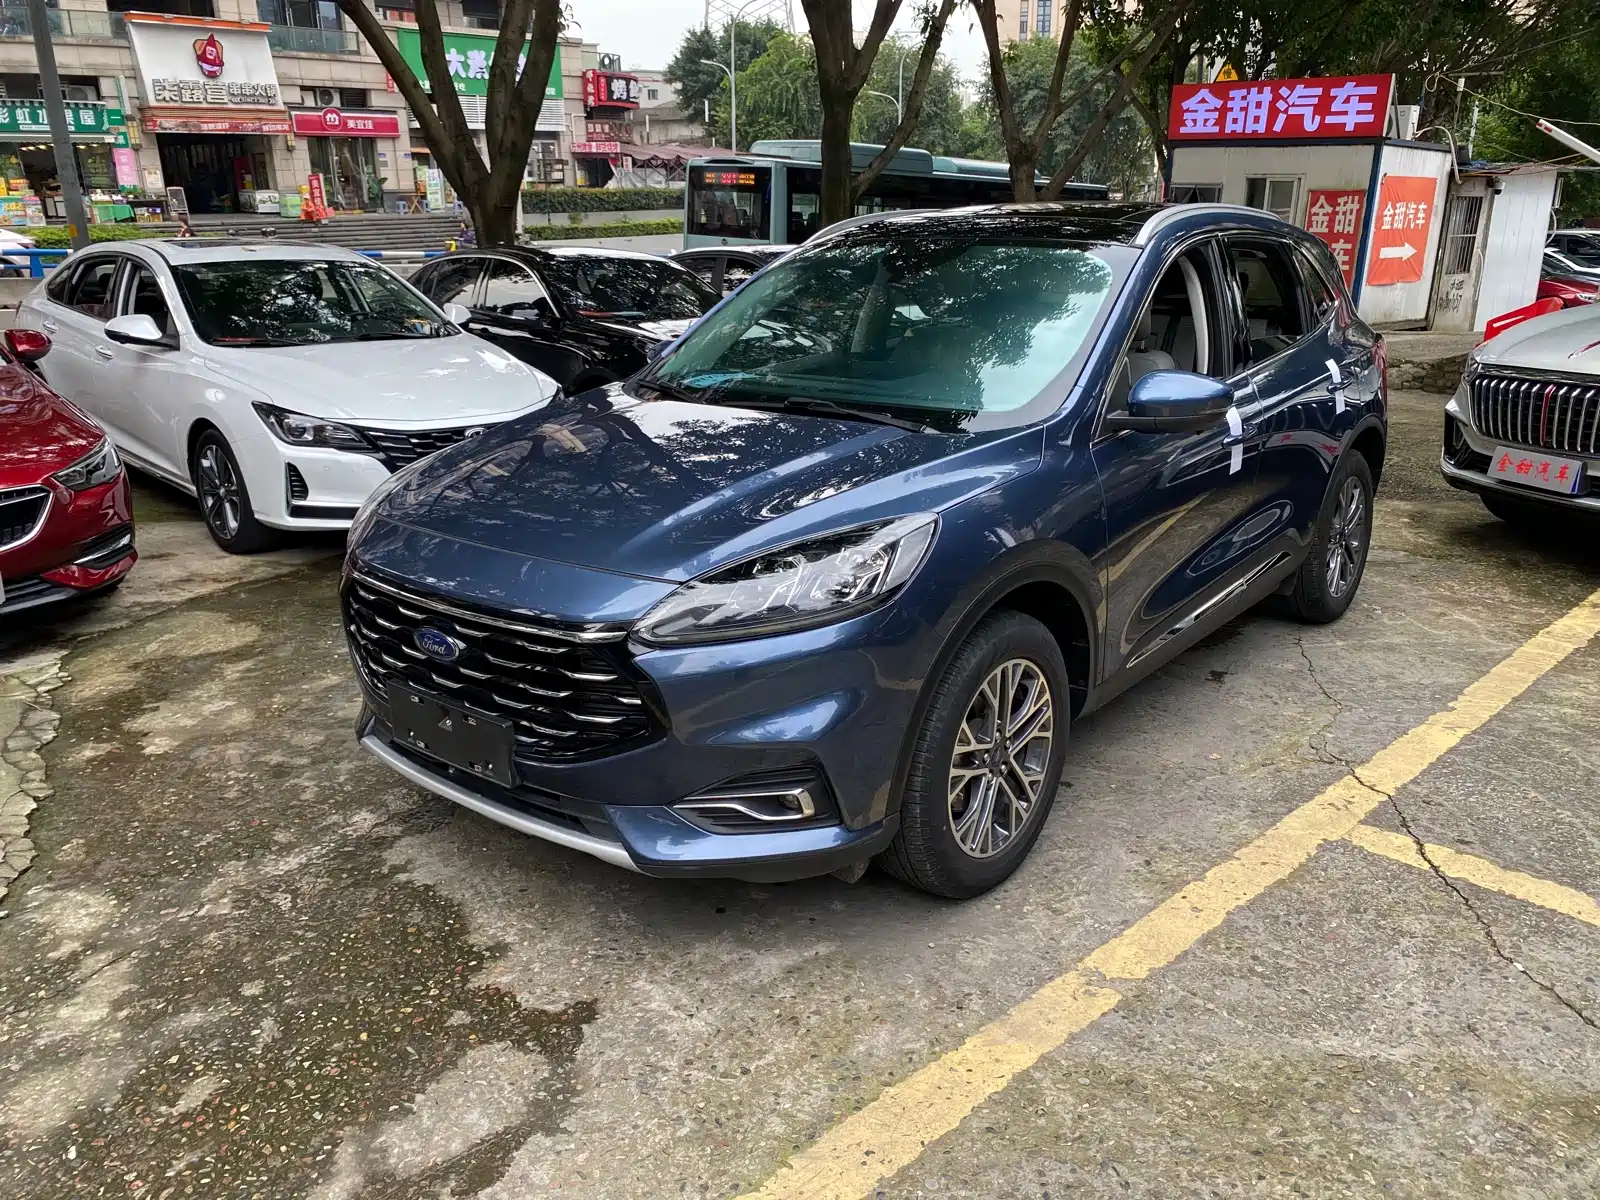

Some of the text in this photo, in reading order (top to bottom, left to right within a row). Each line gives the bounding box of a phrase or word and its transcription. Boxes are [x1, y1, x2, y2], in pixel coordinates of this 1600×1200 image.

[228, 82, 278, 97] 串串火锅
[1180, 81, 1378, 134] 金甜汽车
[347, 119, 375, 130] 美宜佳
[1309, 195, 1360, 234] 金甜
[1381, 201, 1428, 230] 金甜汽车
[1331, 239, 1352, 271] 车
[1496, 452, 1571, 485] 金甜汽车
[423, 635, 447, 655] Ford
